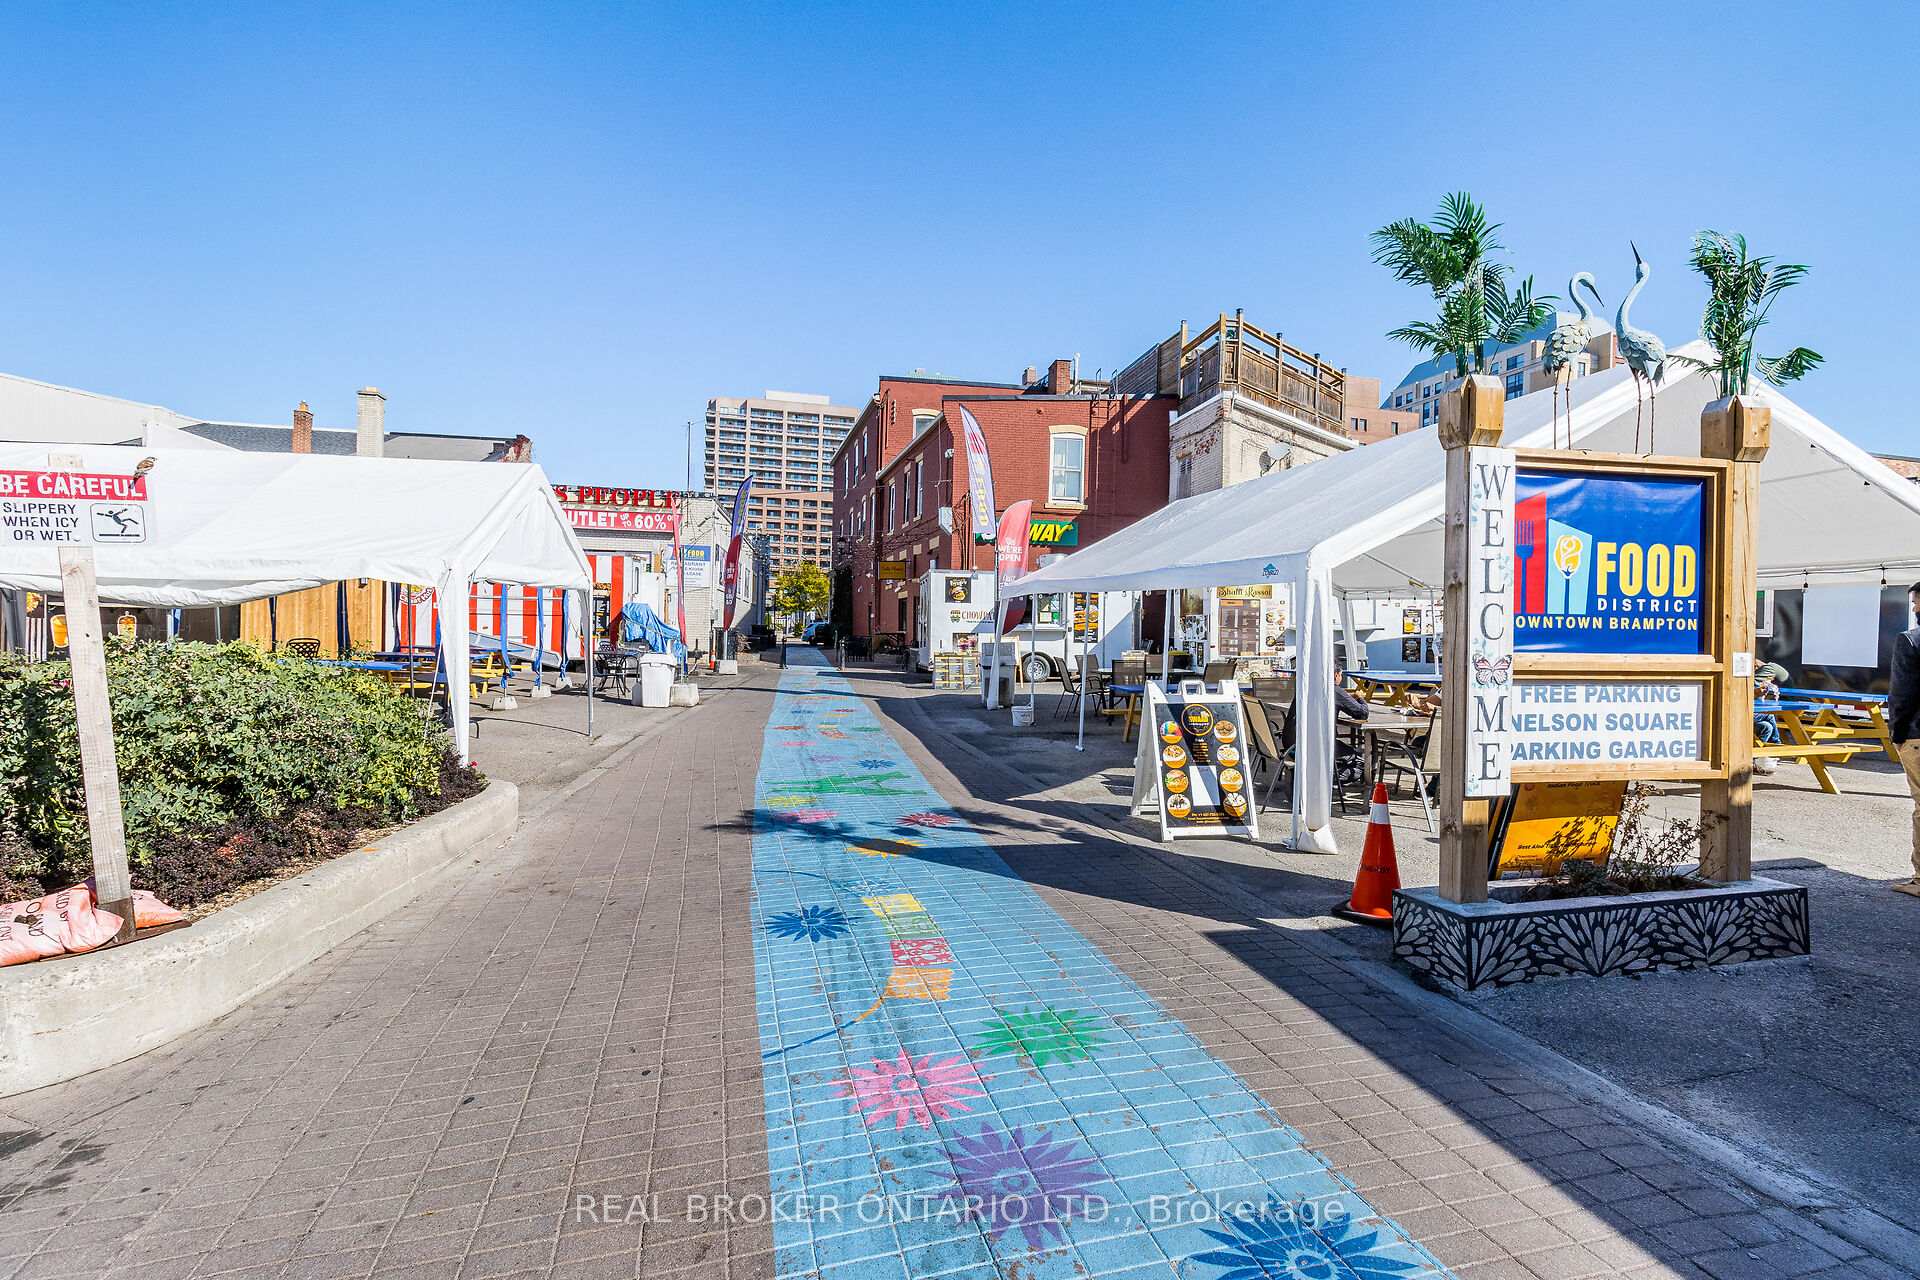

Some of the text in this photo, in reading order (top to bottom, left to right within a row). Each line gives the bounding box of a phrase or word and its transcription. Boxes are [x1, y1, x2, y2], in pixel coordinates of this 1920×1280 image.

[0, 474, 143, 497] BE CAREFUL
[578, 487, 681, 509] PEOPLE
[3, 502, 76, 515] SLIPPERY
[3, 516, 79, 528] WHEN ICY
[634, 515, 666, 529] 60%
[13, 529, 35, 541] OR
[999, 554, 1021, 562] OPEN
[1596, 542, 1697, 597] FOOD
[1597, 598, 1697, 612] DISTRICT
[1515, 615, 1697, 631] OWNTOWN BRAMPTON
[1520, 685, 1681, 703] FREE PARKING
[1512, 713, 1693, 732] NELSON SQUARE
[1608, 740, 1697, 760] GARAGE
